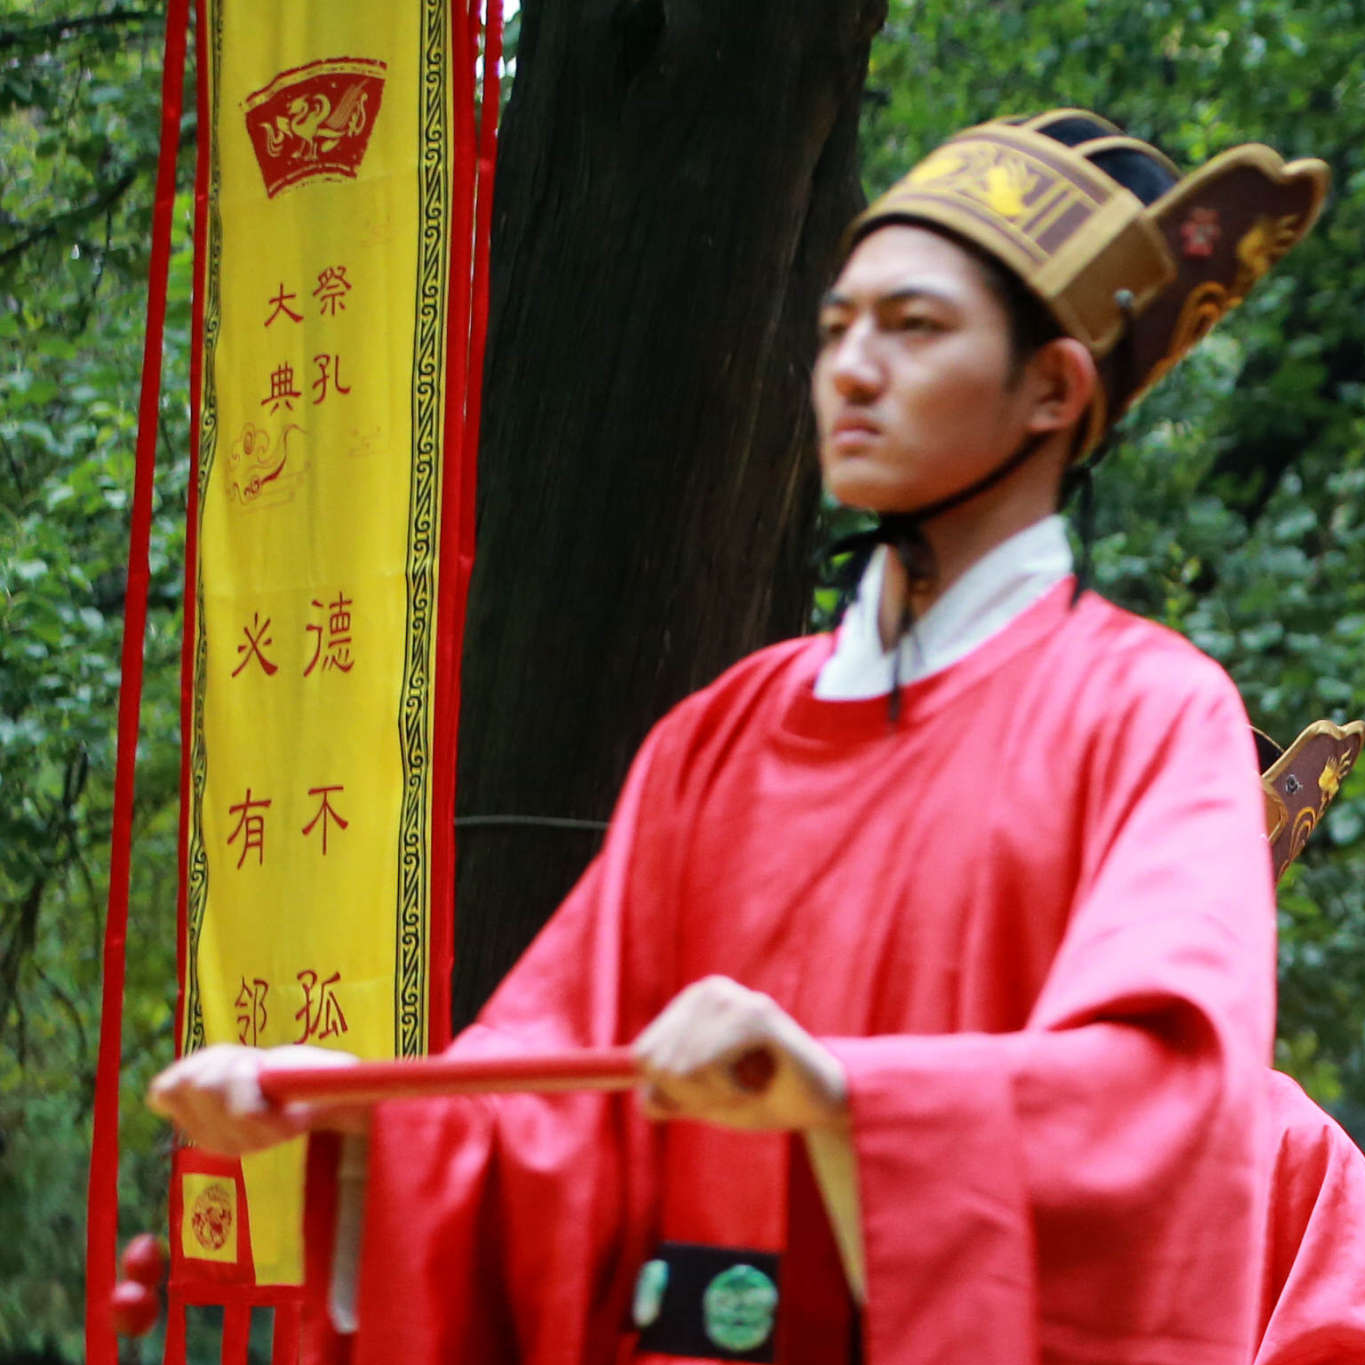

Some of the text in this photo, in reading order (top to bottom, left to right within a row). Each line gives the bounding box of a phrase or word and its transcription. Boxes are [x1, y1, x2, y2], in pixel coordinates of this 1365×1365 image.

[261, 281, 304, 416] 大典
[311, 265, 352, 405] 祭孔
[292, 591, 355, 1046] 德不孤
